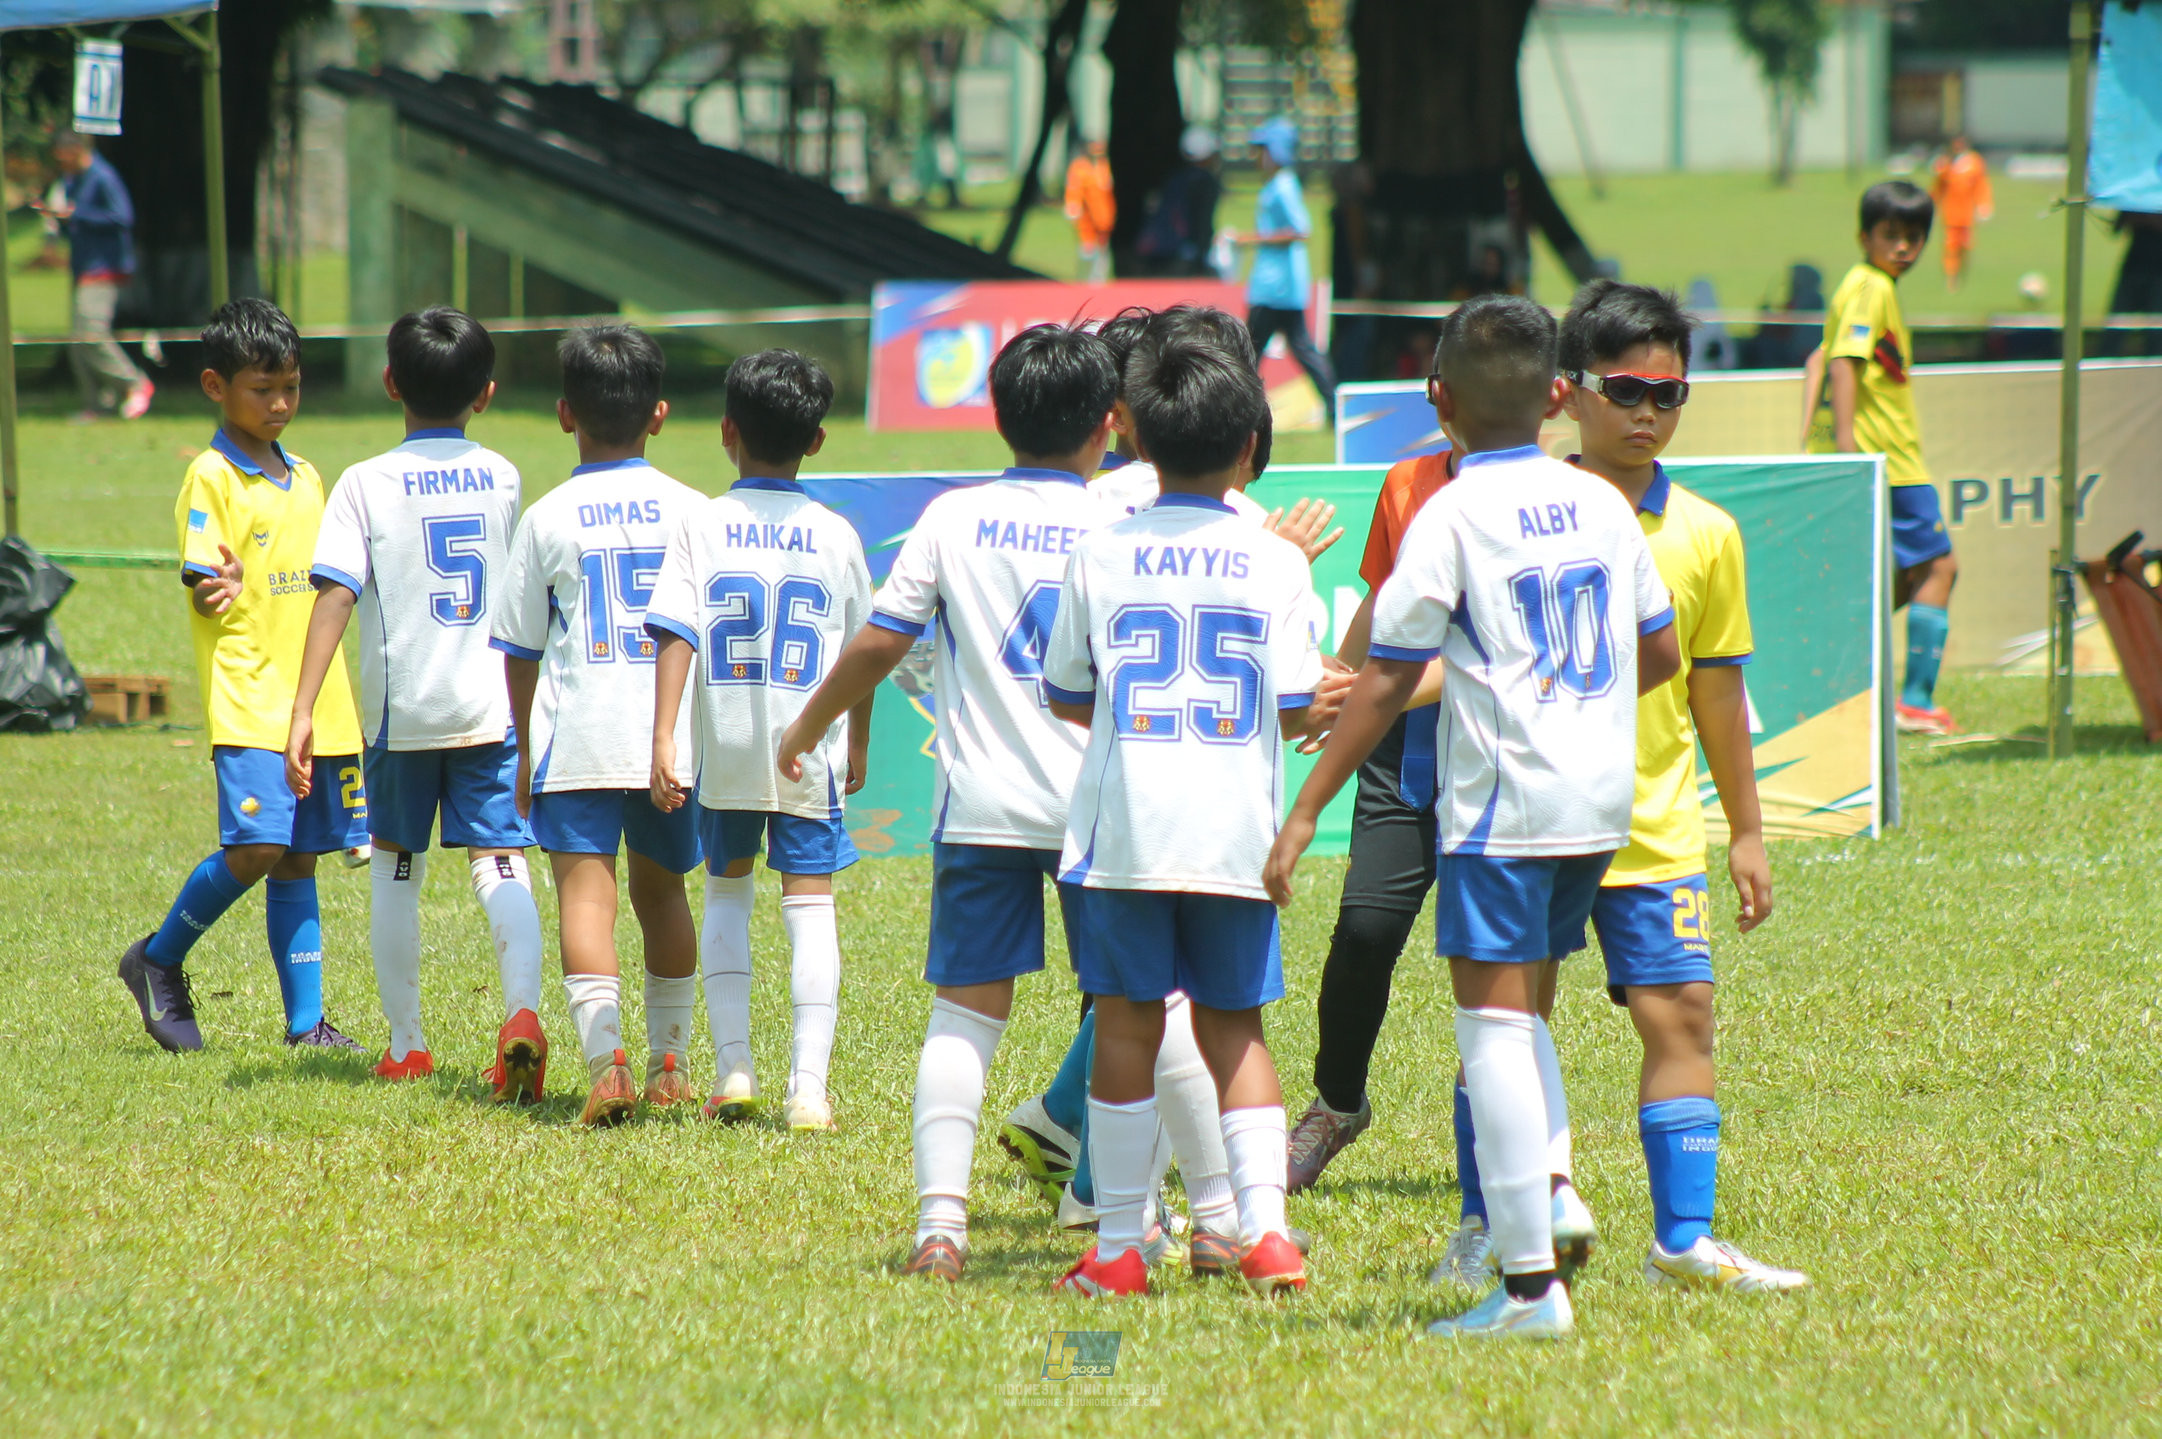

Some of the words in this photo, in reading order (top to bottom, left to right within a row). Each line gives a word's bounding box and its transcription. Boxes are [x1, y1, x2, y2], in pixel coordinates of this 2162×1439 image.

[403, 467, 494, 496] FIRMAN
[578, 500, 661, 528] DIMAS
[975, 518, 1090, 555] MAHEE
[1517, 501, 1579, 539] ALBY
[726, 523, 817, 554] HAIKAL
[1133, 546, 1250, 579] KAYYIS
[421, 513, 487, 627] 5
[579, 546, 667, 664] 15
[704, 571, 832, 692] 26
[995, 579, 1064, 708] 4
[1508, 557, 1618, 703] 10
[1106, 603, 1272, 745] 25
[339, 766, 366, 808] 2
[1673, 887, 1709, 941] 28
